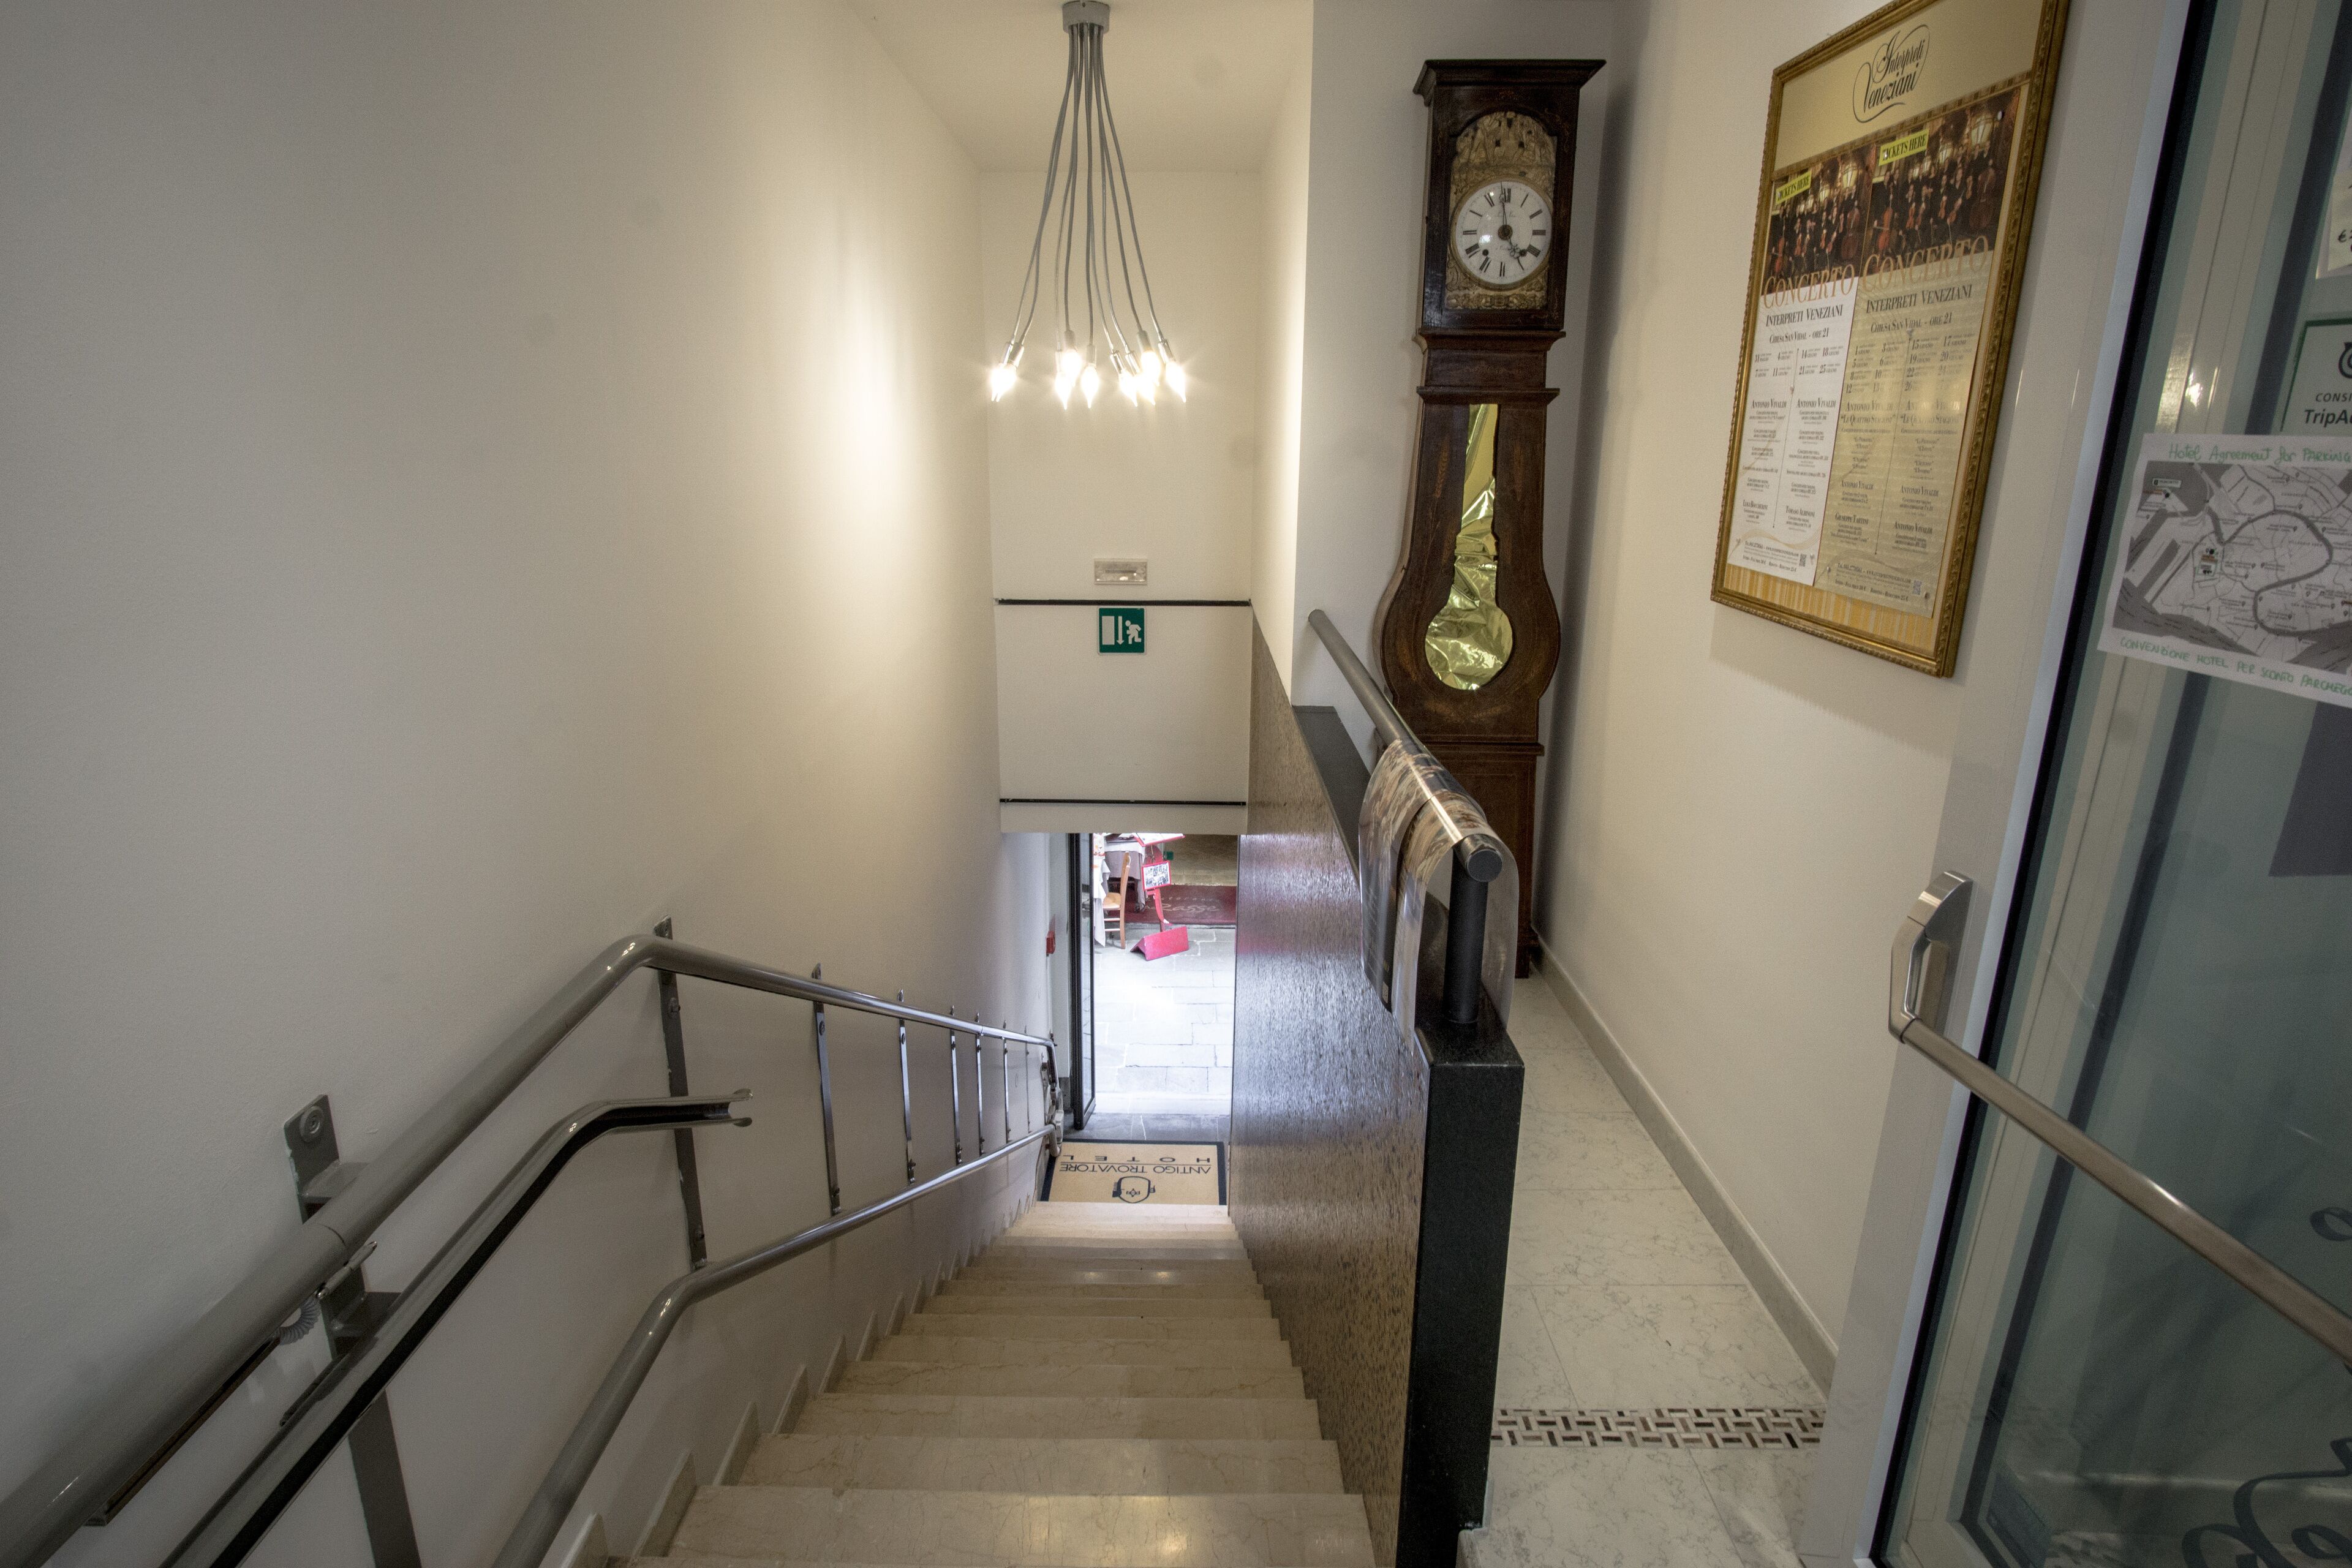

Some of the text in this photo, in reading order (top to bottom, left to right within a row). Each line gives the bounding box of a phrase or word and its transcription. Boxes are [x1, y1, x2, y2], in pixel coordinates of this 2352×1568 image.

[1872, 29, 1926, 83] Interpreti
[1853, 62, 1920, 118] Veneziani
[1909, 133, 1927, 151] HERE
[1797, 175, 1811, 190] HERE
[1862, 235, 1988, 292] CONCERTO
[1763, 263, 1855, 309] CONCERTO
[1866, 284, 1972, 314] INTERPRETI VENEZIANI
[1766, 304, 1843, 326] INTERPRETI VENEZIANI
[1891, 320, 1904, 330] SAN
[1904, 318, 1921, 328] VIDAL
[1929, 317, 1942, 326] ORE
[1943, 315, 1952, 325] 21
[1822, 328, 1829, 337] 21
[1752, 398, 1787, 409] ANTONIO VIVALDI
[1796, 398, 1836, 409] ANTONIO VIVALDI
[2304, 409, 2352, 428] TripA
[2169, 443, 2201, 461] Hotel
[2209, 445, 2273, 464] Agreement
[2197, 654, 2229, 669] HOTEL
[2237, 661, 2256, 674] PER
[1063, 1155, 1210, 1163] HOTEL
[1059, 1164, 1147, 1174] TROVATORE
